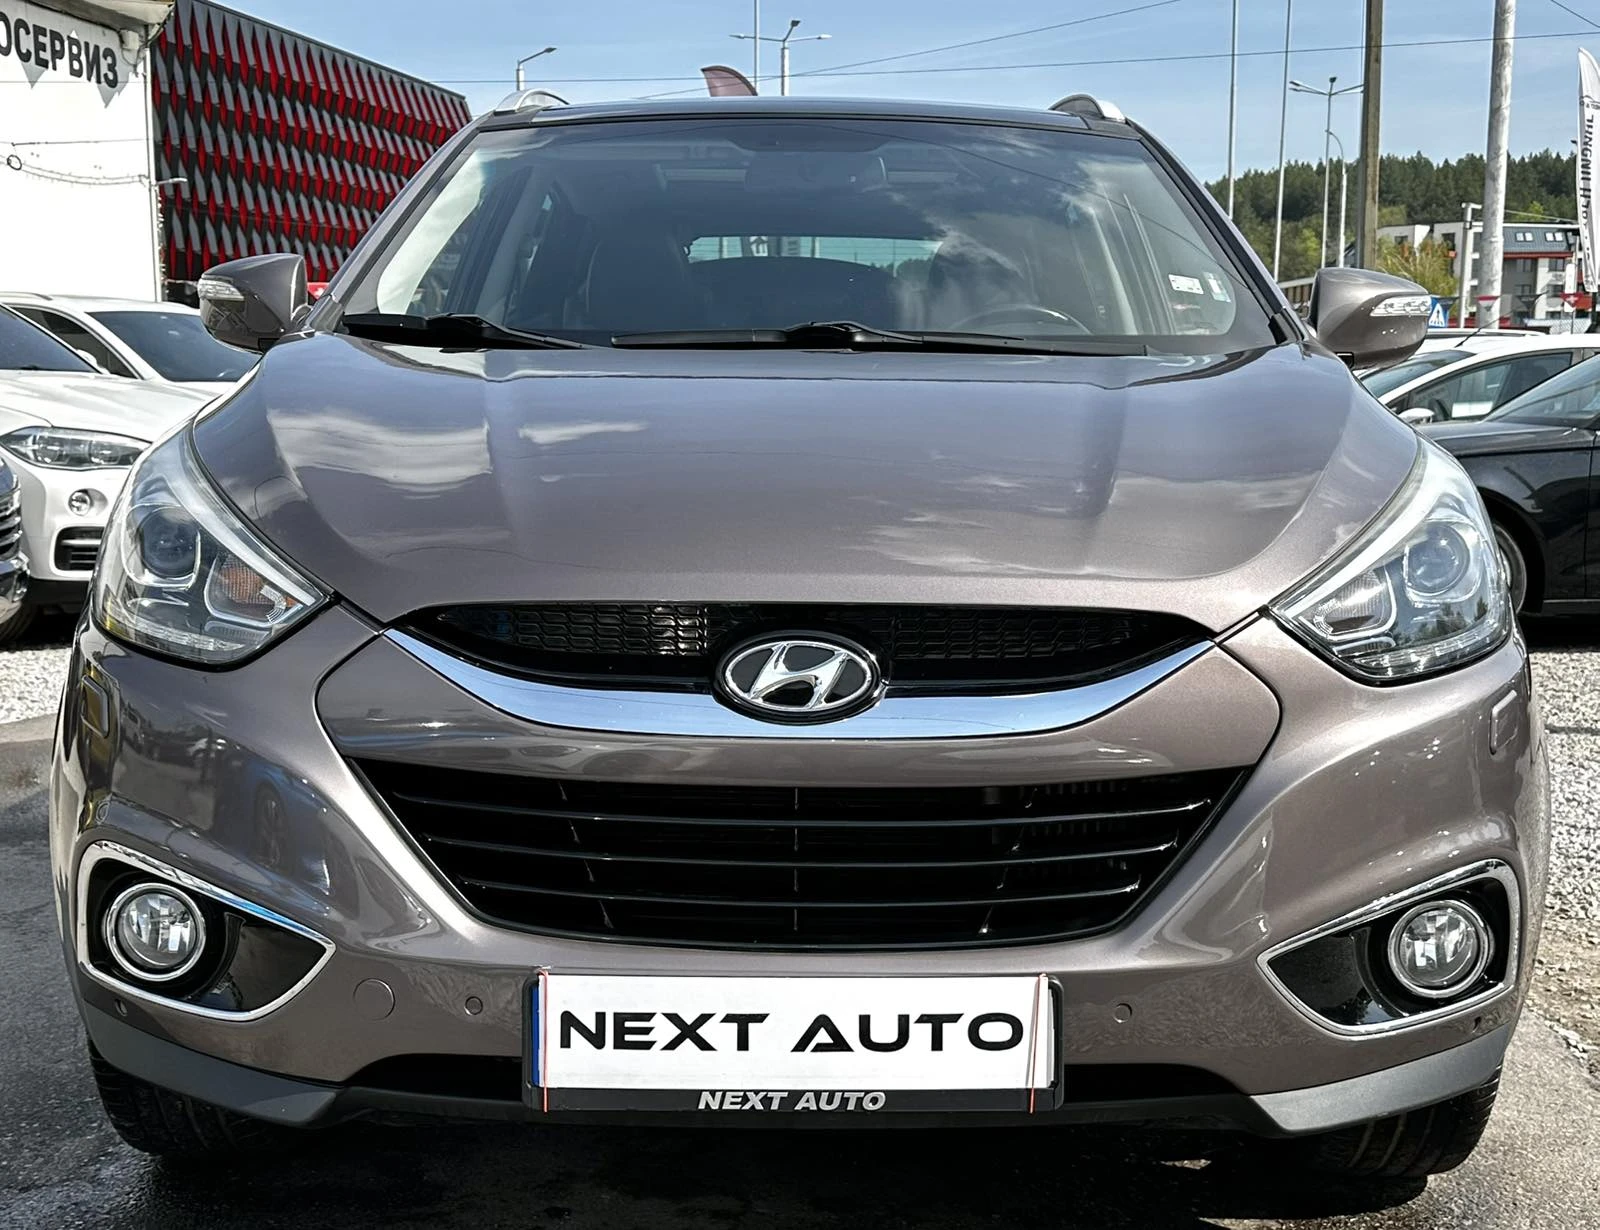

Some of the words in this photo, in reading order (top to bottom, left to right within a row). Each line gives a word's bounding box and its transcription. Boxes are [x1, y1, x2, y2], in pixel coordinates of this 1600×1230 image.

[560, 1011, 770, 1052] NEXT
[790, 1012, 1024, 1053] AUTO
[698, 1090, 788, 1110] NEXT
[797, 1091, 887, 1111] AUTO
